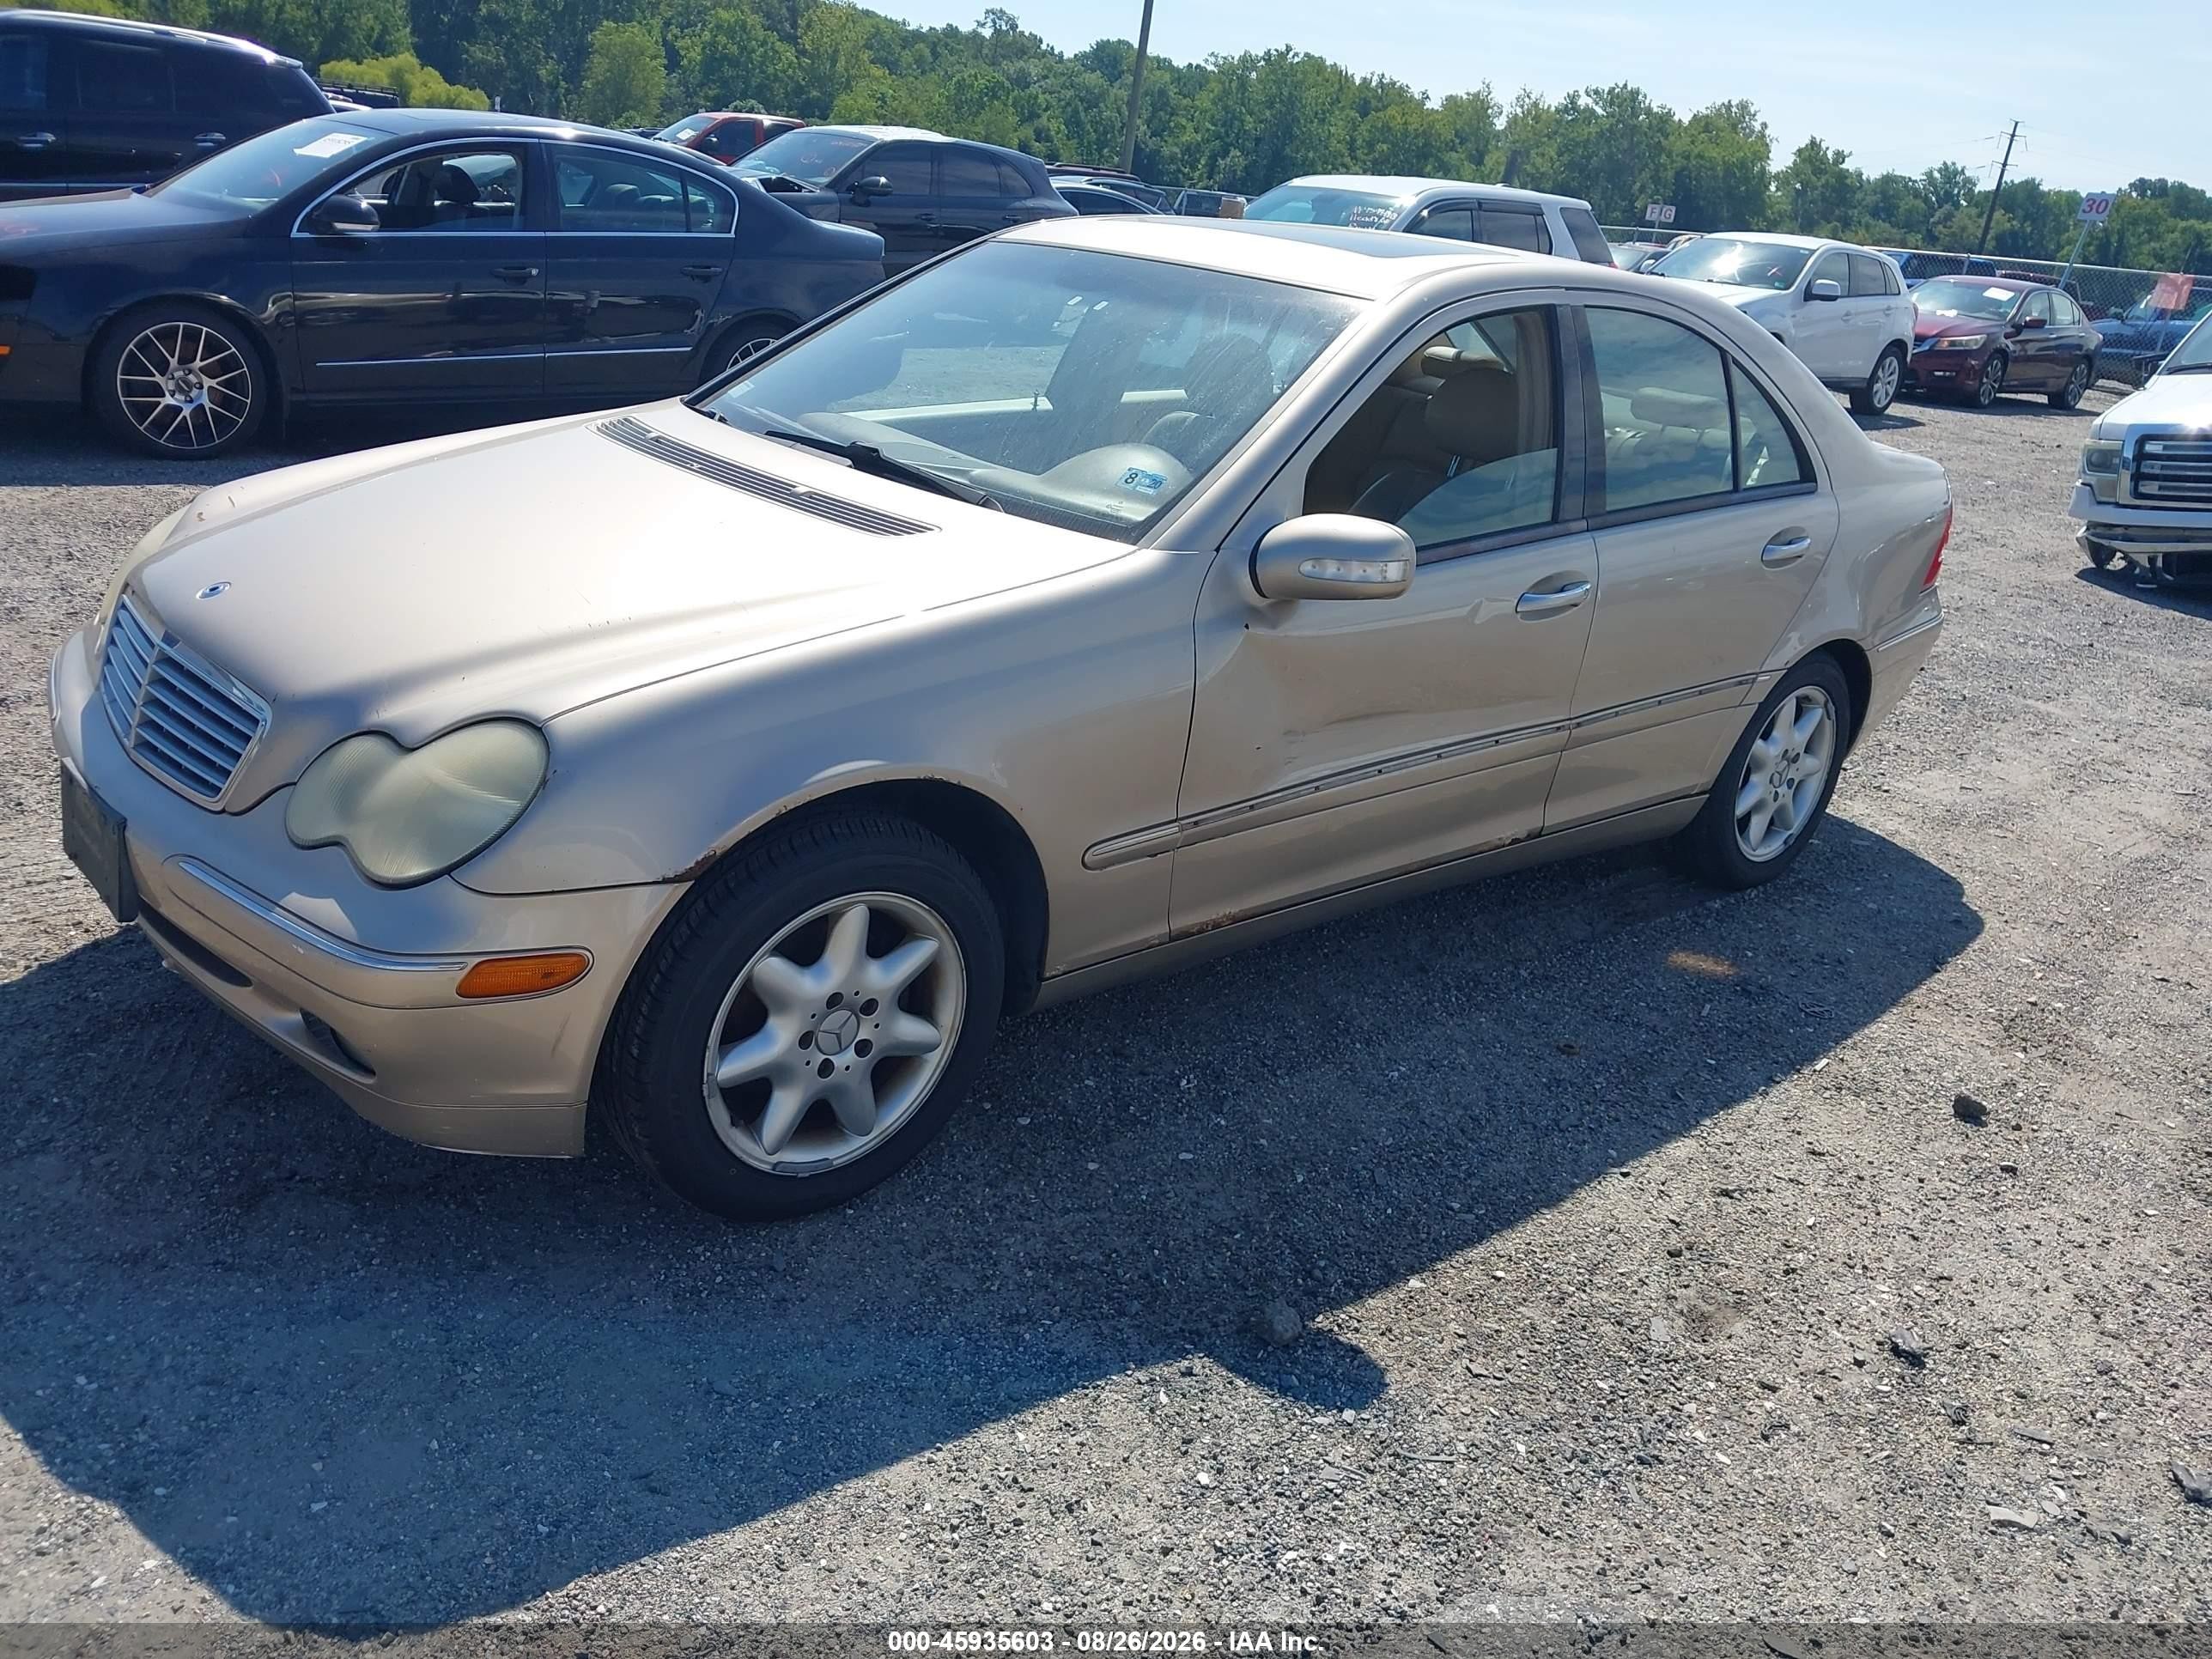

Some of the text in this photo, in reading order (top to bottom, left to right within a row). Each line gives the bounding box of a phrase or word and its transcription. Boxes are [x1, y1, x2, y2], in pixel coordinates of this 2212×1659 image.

[2081, 198, 2110, 214] 30
[1663, 208, 1674, 220] G
[1124, 472, 1139, 484] 8
